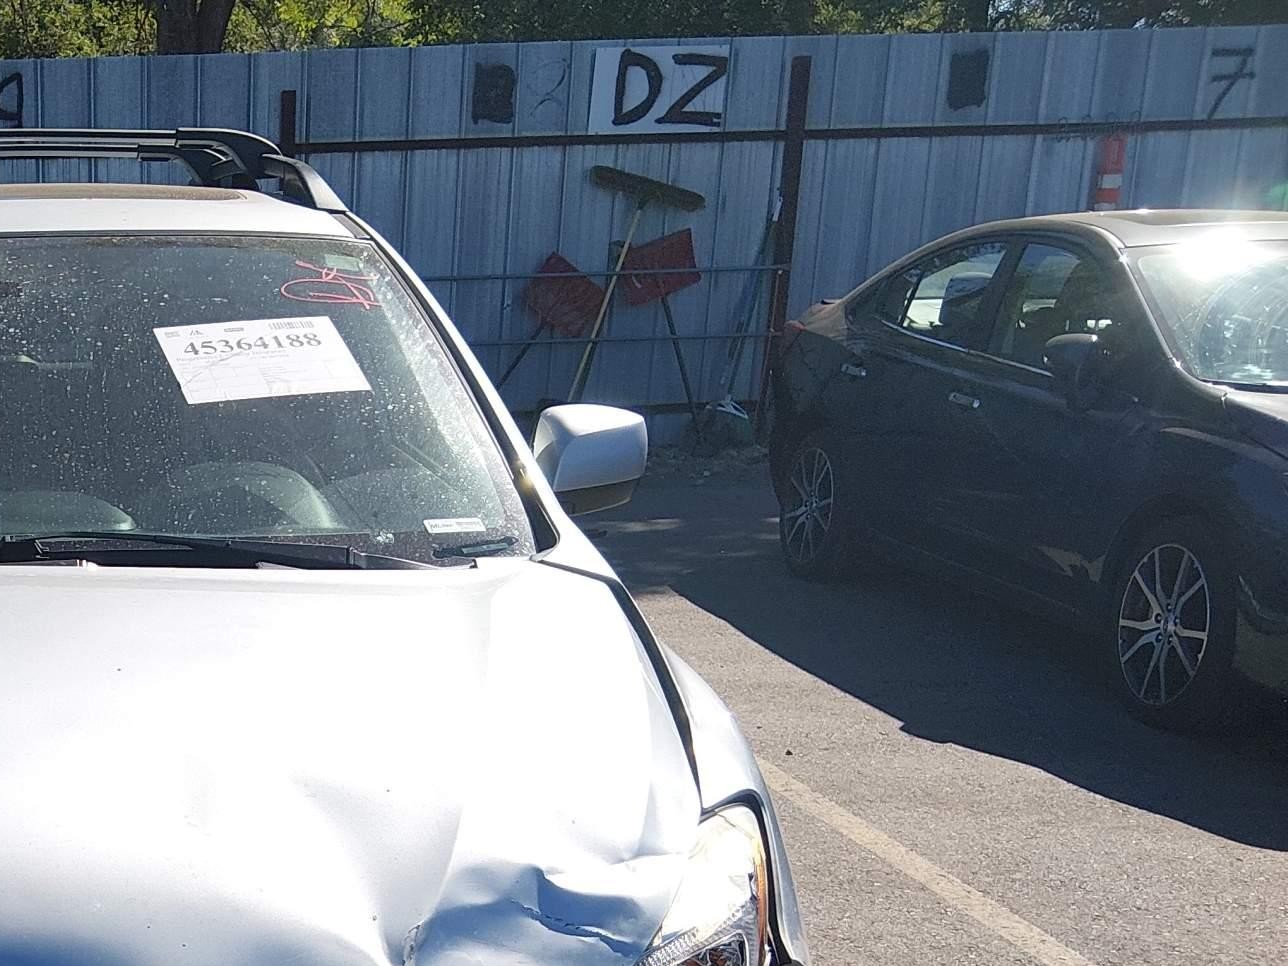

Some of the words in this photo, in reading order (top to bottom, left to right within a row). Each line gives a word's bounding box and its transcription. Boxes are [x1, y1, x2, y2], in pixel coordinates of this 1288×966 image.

[611, 48, 729, 127] DZ
[1207, 46, 1256, 120] 7
[183, 332, 323, 356] 45364188
